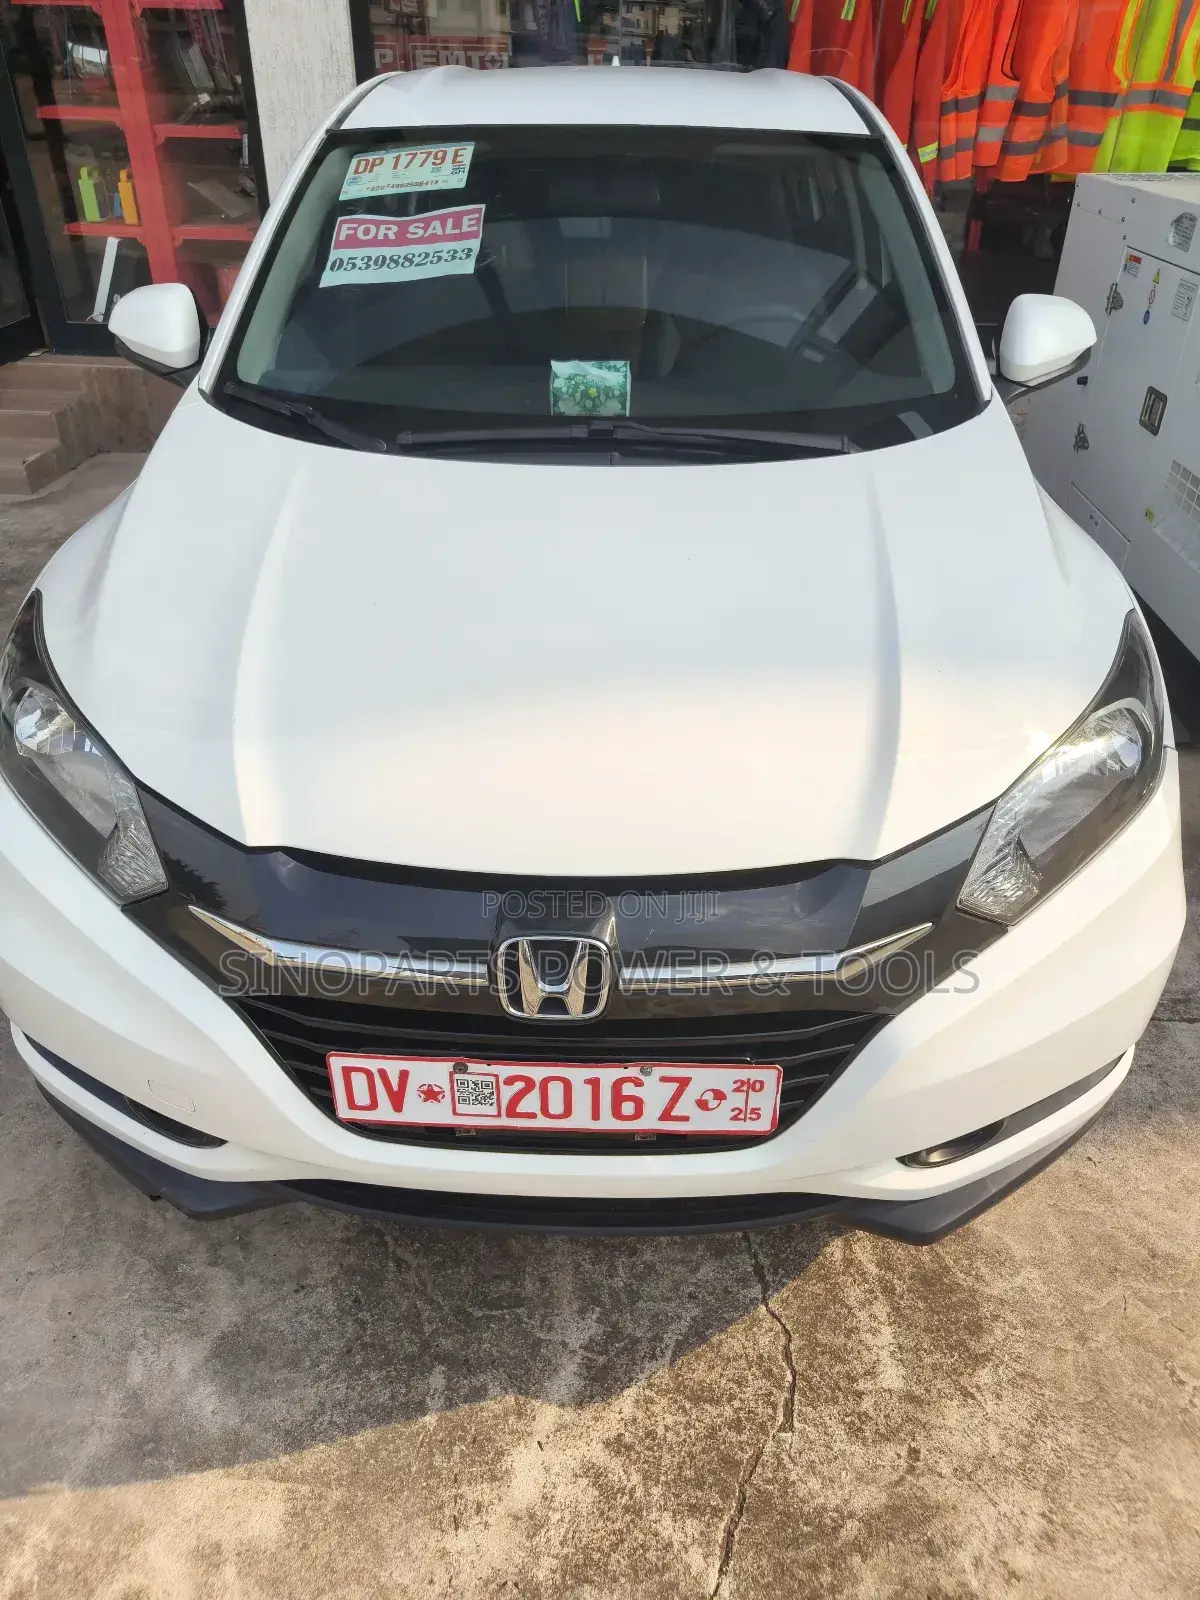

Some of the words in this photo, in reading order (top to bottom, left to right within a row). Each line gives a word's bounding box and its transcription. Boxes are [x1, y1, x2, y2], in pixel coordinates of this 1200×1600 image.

[353, 157, 384, 175] DP
[392, 149, 447, 170] 1779
[451, 148, 467, 164] E
[338, 223, 399, 241] FOR
[406, 214, 479, 239] SALE
[330, 248, 473, 272] 0539882533
[341, 1065, 410, 1113] DV
[503, 1075, 646, 1122] 2016
[657, 1075, 692, 1122] Z
